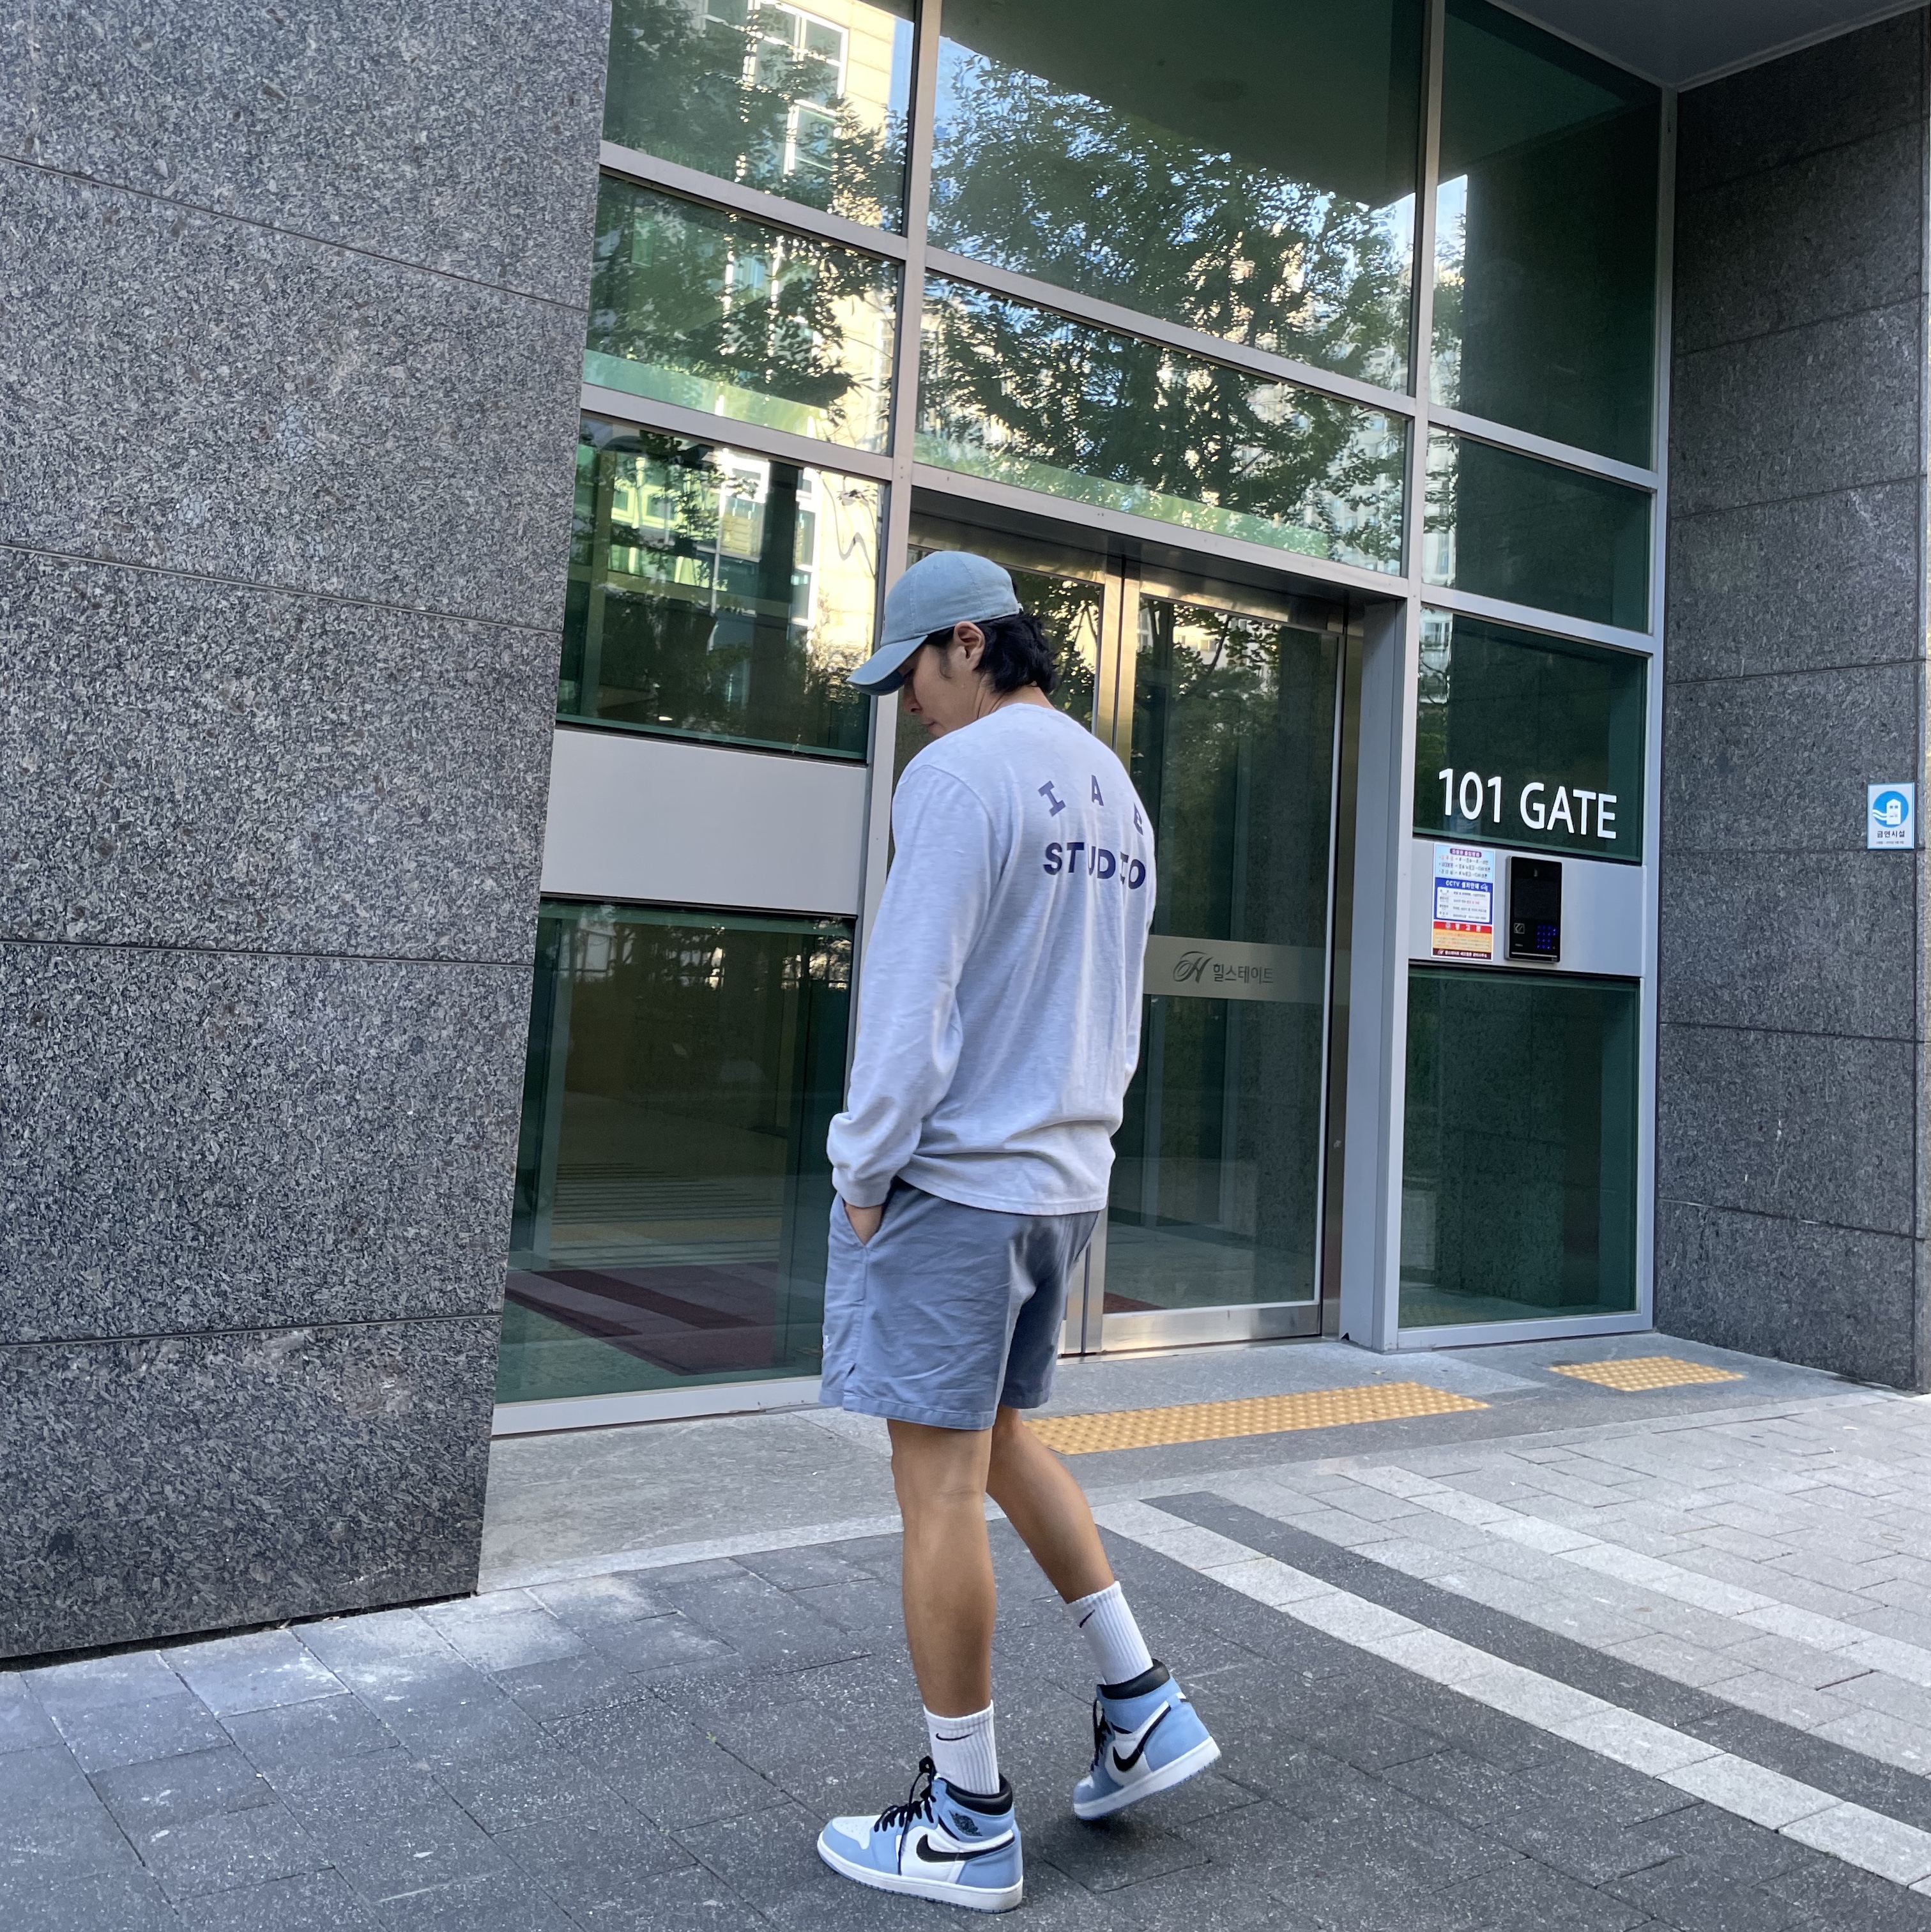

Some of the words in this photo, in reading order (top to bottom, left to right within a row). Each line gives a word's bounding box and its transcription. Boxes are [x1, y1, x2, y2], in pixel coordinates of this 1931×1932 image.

[1439, 768, 1502, 823] 101
[1520, 782, 1617, 839] GATE
[1042, 842, 1146, 890] STUDIO
[1213, 963, 1274, 985] 힐스테이트
